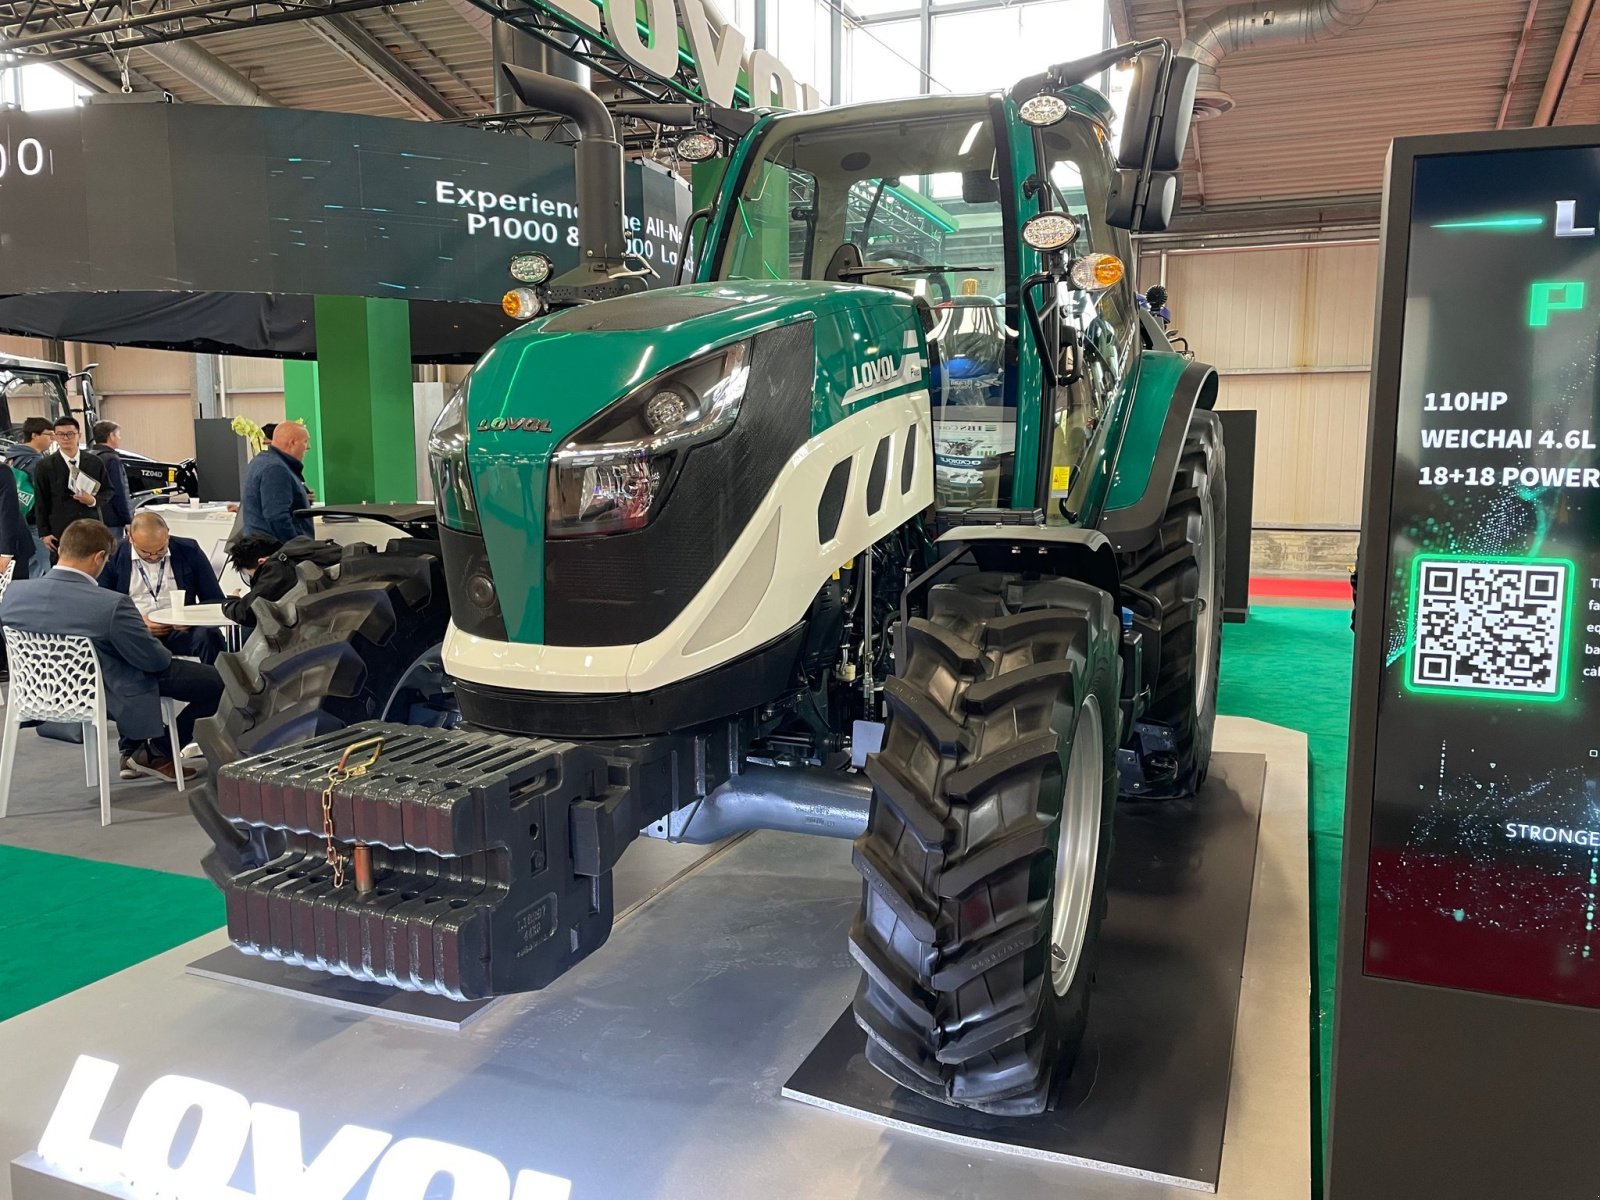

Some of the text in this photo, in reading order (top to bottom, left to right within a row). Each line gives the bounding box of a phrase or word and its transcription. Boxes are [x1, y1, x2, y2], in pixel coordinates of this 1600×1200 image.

[545, 0, 819, 110] OVO
[467, 213, 557, 244] P1000
[566, 225, 579, 247] &
[1555, 200, 1600, 236] L
[1529, 282, 1584, 326] P
[852, 355, 898, 391] LOVOL
[1423, 391, 1508, 412] 110HP
[477, 417, 552, 433] LOVOL
[1420, 429, 1597, 449] WEICHAI 4.6L
[1418, 466, 1495, 486] 18+18
[37, 1054, 573, 1200] LOVO
